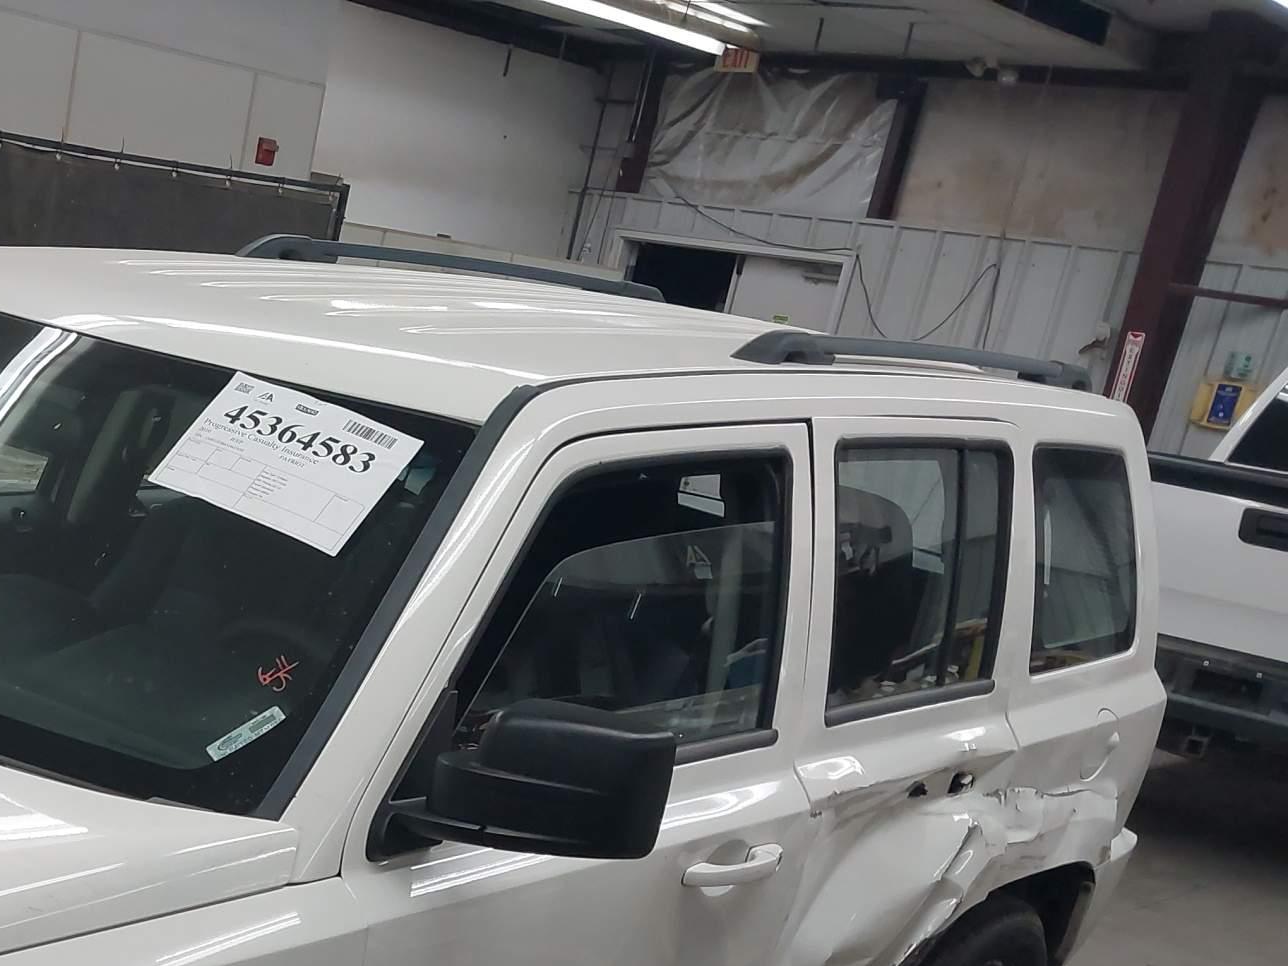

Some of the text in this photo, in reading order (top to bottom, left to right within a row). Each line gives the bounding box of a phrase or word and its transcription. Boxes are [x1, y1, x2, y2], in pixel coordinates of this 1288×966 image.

[205, 417, 248, 437] Progressive
[247, 432, 281, 451] Casualty
[280, 445, 320, 465] Insurance
[223, 404, 376, 474] 45364583
